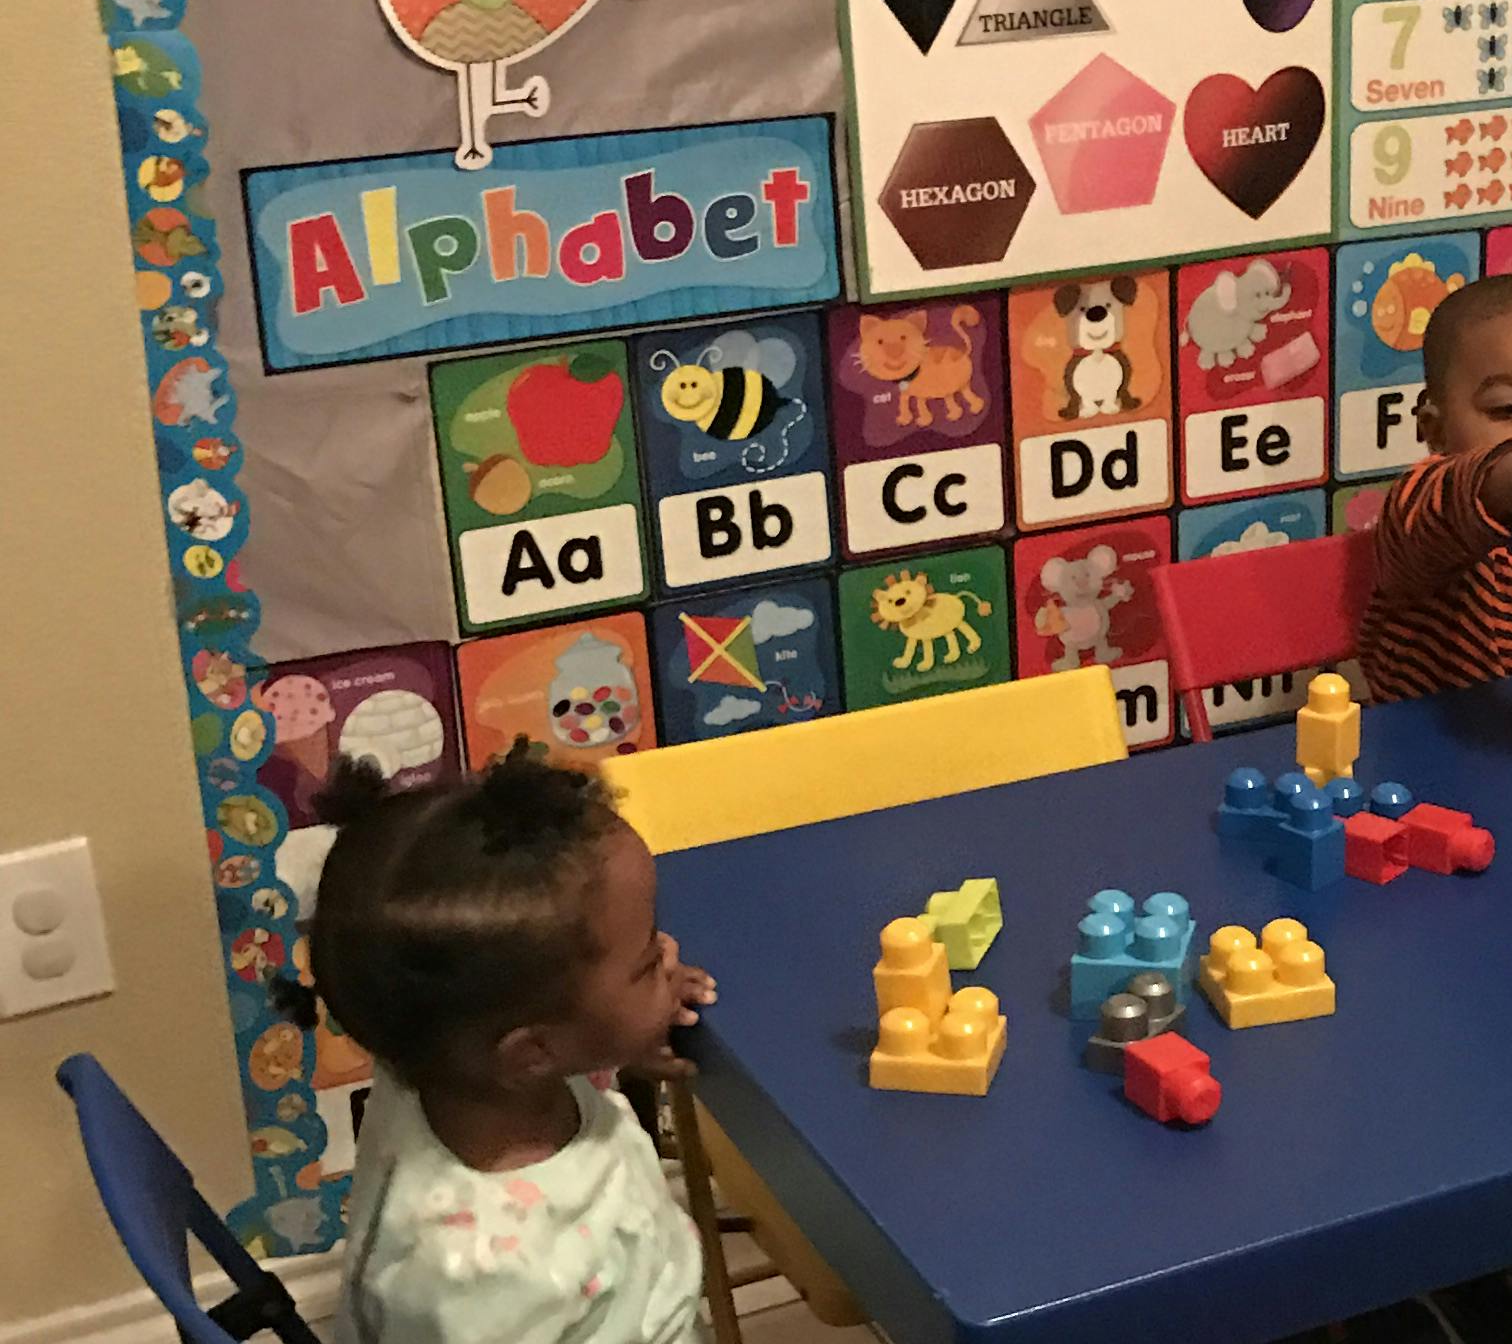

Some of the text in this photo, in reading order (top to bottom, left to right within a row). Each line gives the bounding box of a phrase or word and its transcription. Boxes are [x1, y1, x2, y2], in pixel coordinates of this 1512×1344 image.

[978, 6, 1093, 34] TRIANGLE
[1382, 4, 1422, 71] 7
[1365, 79, 1445, 104] Seven
[1045, 113, 1163, 143] PENTAGON
[1222, 123, 1289, 148] HEART
[1373, 124, 1412, 186] 9
[900, 179, 1016, 209] HEXAGON
[1368, 196, 1425, 219] Nine
[287, 167, 809, 316] Alphabet
[1049, 430, 1140, 499] Dd
[1218, 414, 1292, 474] Ee
[881, 462, 968, 524] Cc
[698, 489, 794, 560] Bb
[499, 529, 603, 596] Aa
